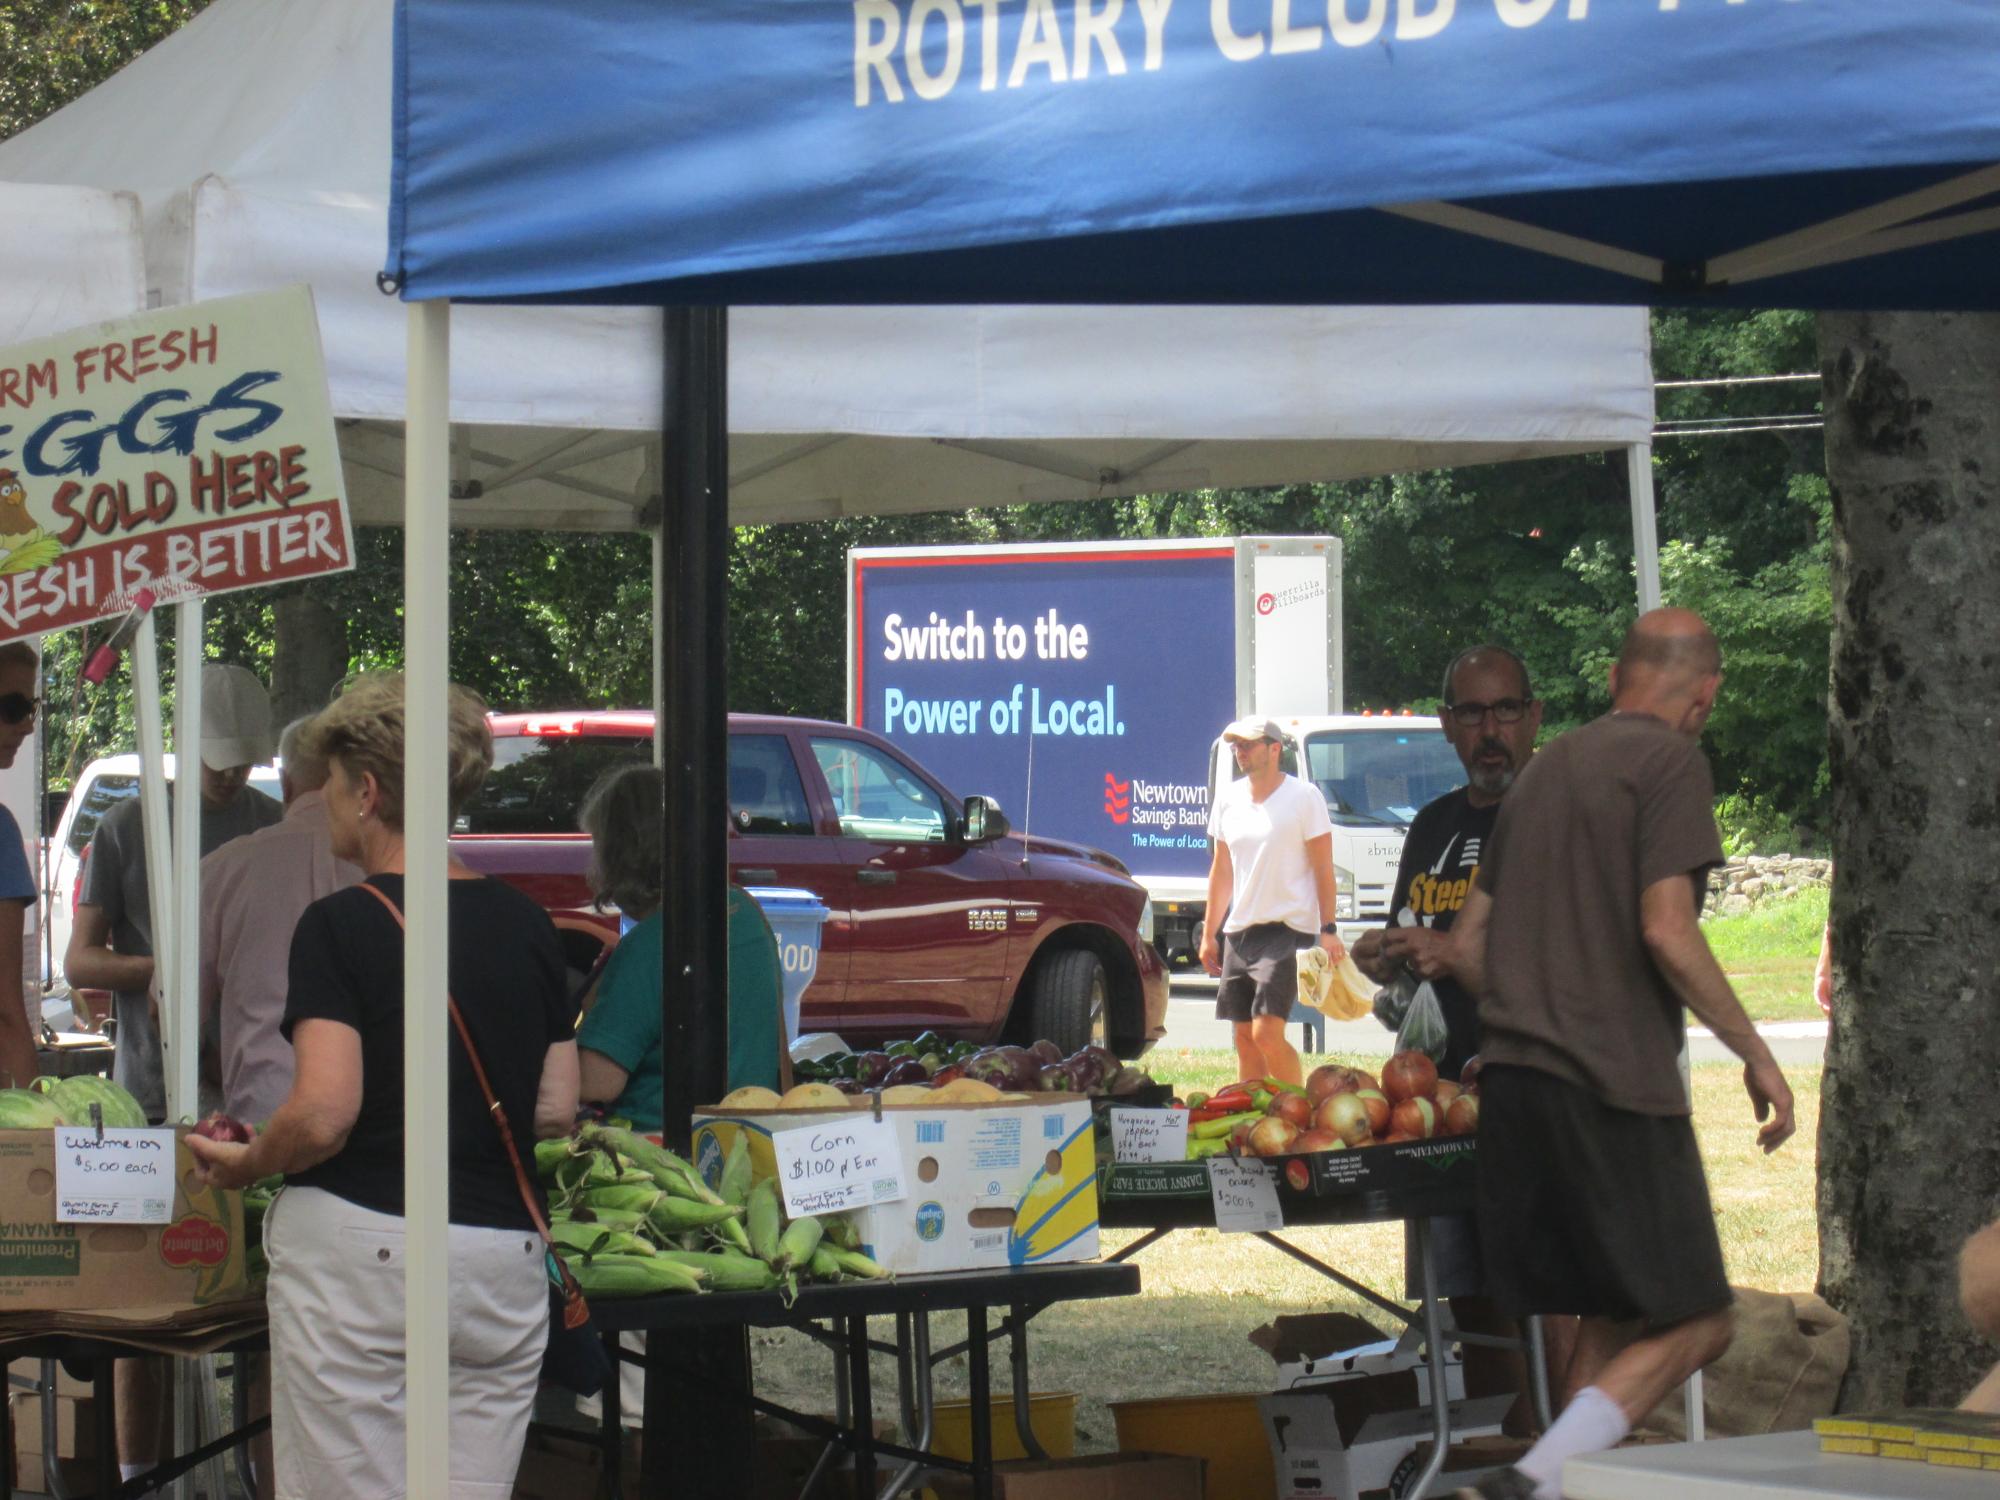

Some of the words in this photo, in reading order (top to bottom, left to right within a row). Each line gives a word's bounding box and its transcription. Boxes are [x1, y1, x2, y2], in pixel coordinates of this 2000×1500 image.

[854, 0, 1172, 106] ROTARY
[74, 323, 218, 394] FRESH
[52, 470, 178, 547] SOLD
[190, 445, 310, 514] HERE
[113, 544, 151, 593] IS
[167, 511, 341, 579] BETTER
[884, 610, 985, 661] Switch
[993, 617, 1027, 660] to
[1034, 608, 1089, 660] the
[885, 687, 981, 734] Power
[989, 684, 1024, 735] of
[1032, 685, 1125, 735] Local.
[1132, 779, 1209, 804] Newtown
[1132, 806, 1177, 830] Savings
[1178, 807, 1208, 825] Bank
[1132, 833, 1148, 847] The
[1149, 834, 1175, 847] Power
[1177, 833, 1187, 848] of
[1188, 834, 1208, 849] Loca
[968, 908, 1007, 920] RAM
[968, 920, 1007, 931] 1500
[777, 944, 813, 972] OD
[811, 1134, 856, 1153] Corn
[1410, 1141, 1461, 1159] MOUNTAIN
[75, 1155, 120, 1173] $5.00
[125, 1160, 157, 1175] each
[789, 1157, 835, 1181] $1.00
[854, 1154, 878, 1170] Ear
[1136, 1176, 1168, 1190] DICKIE
[1170, 1173, 1204, 1190] DANNY
[0, 1242, 76, 1260] Premium
